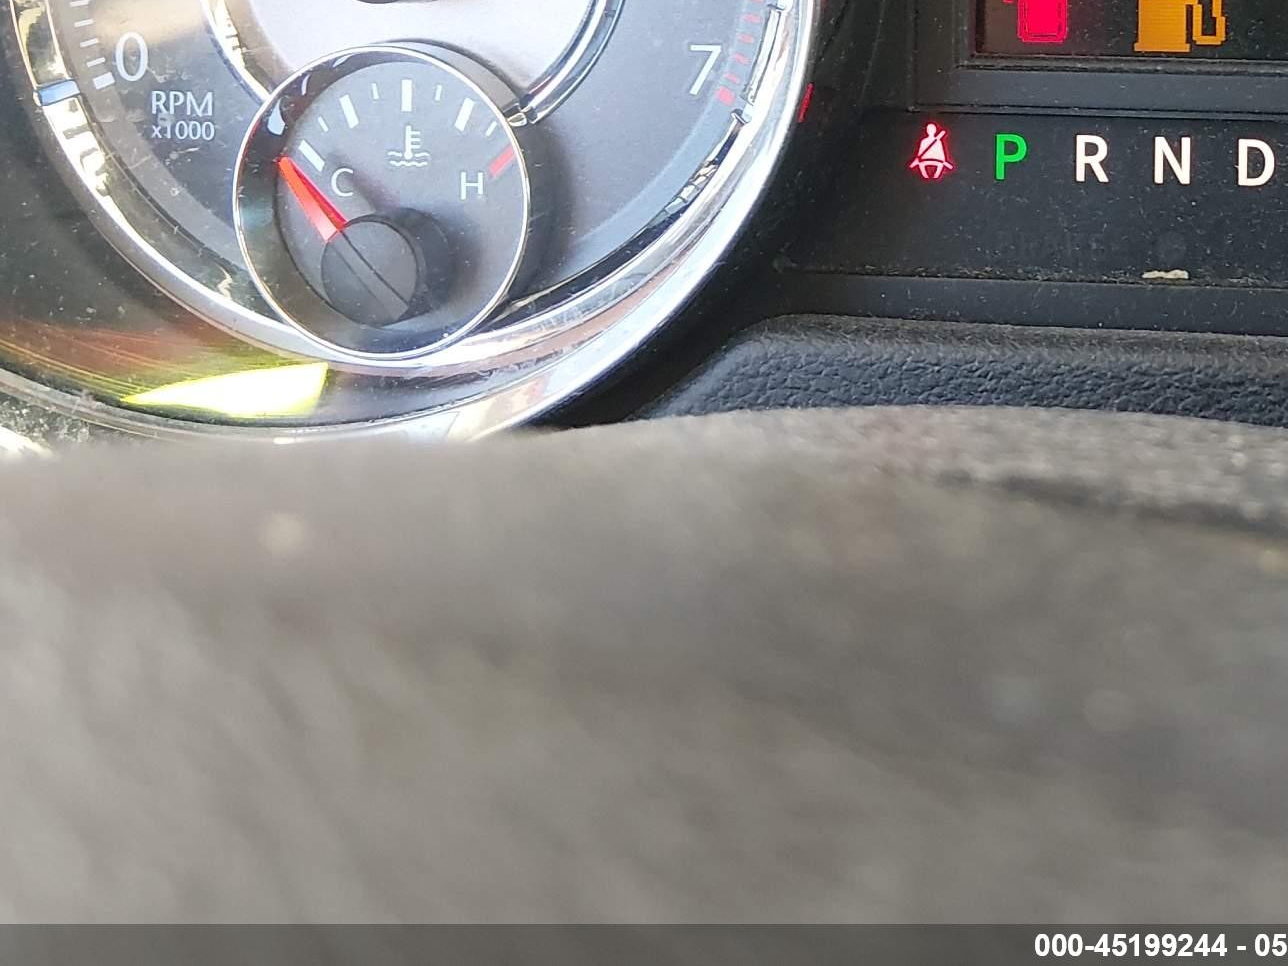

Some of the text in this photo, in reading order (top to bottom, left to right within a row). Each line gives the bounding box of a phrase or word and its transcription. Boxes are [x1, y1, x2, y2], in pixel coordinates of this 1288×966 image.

[116, 32, 148, 81] 0
[689, 45, 722, 95] 7
[152, 91, 213, 116] RPM
[152, 121, 215, 141] x1000
[996, 134, 1276, 186] P R N D
[331, 168, 354, 197] C
[460, 173, 484, 200] H
